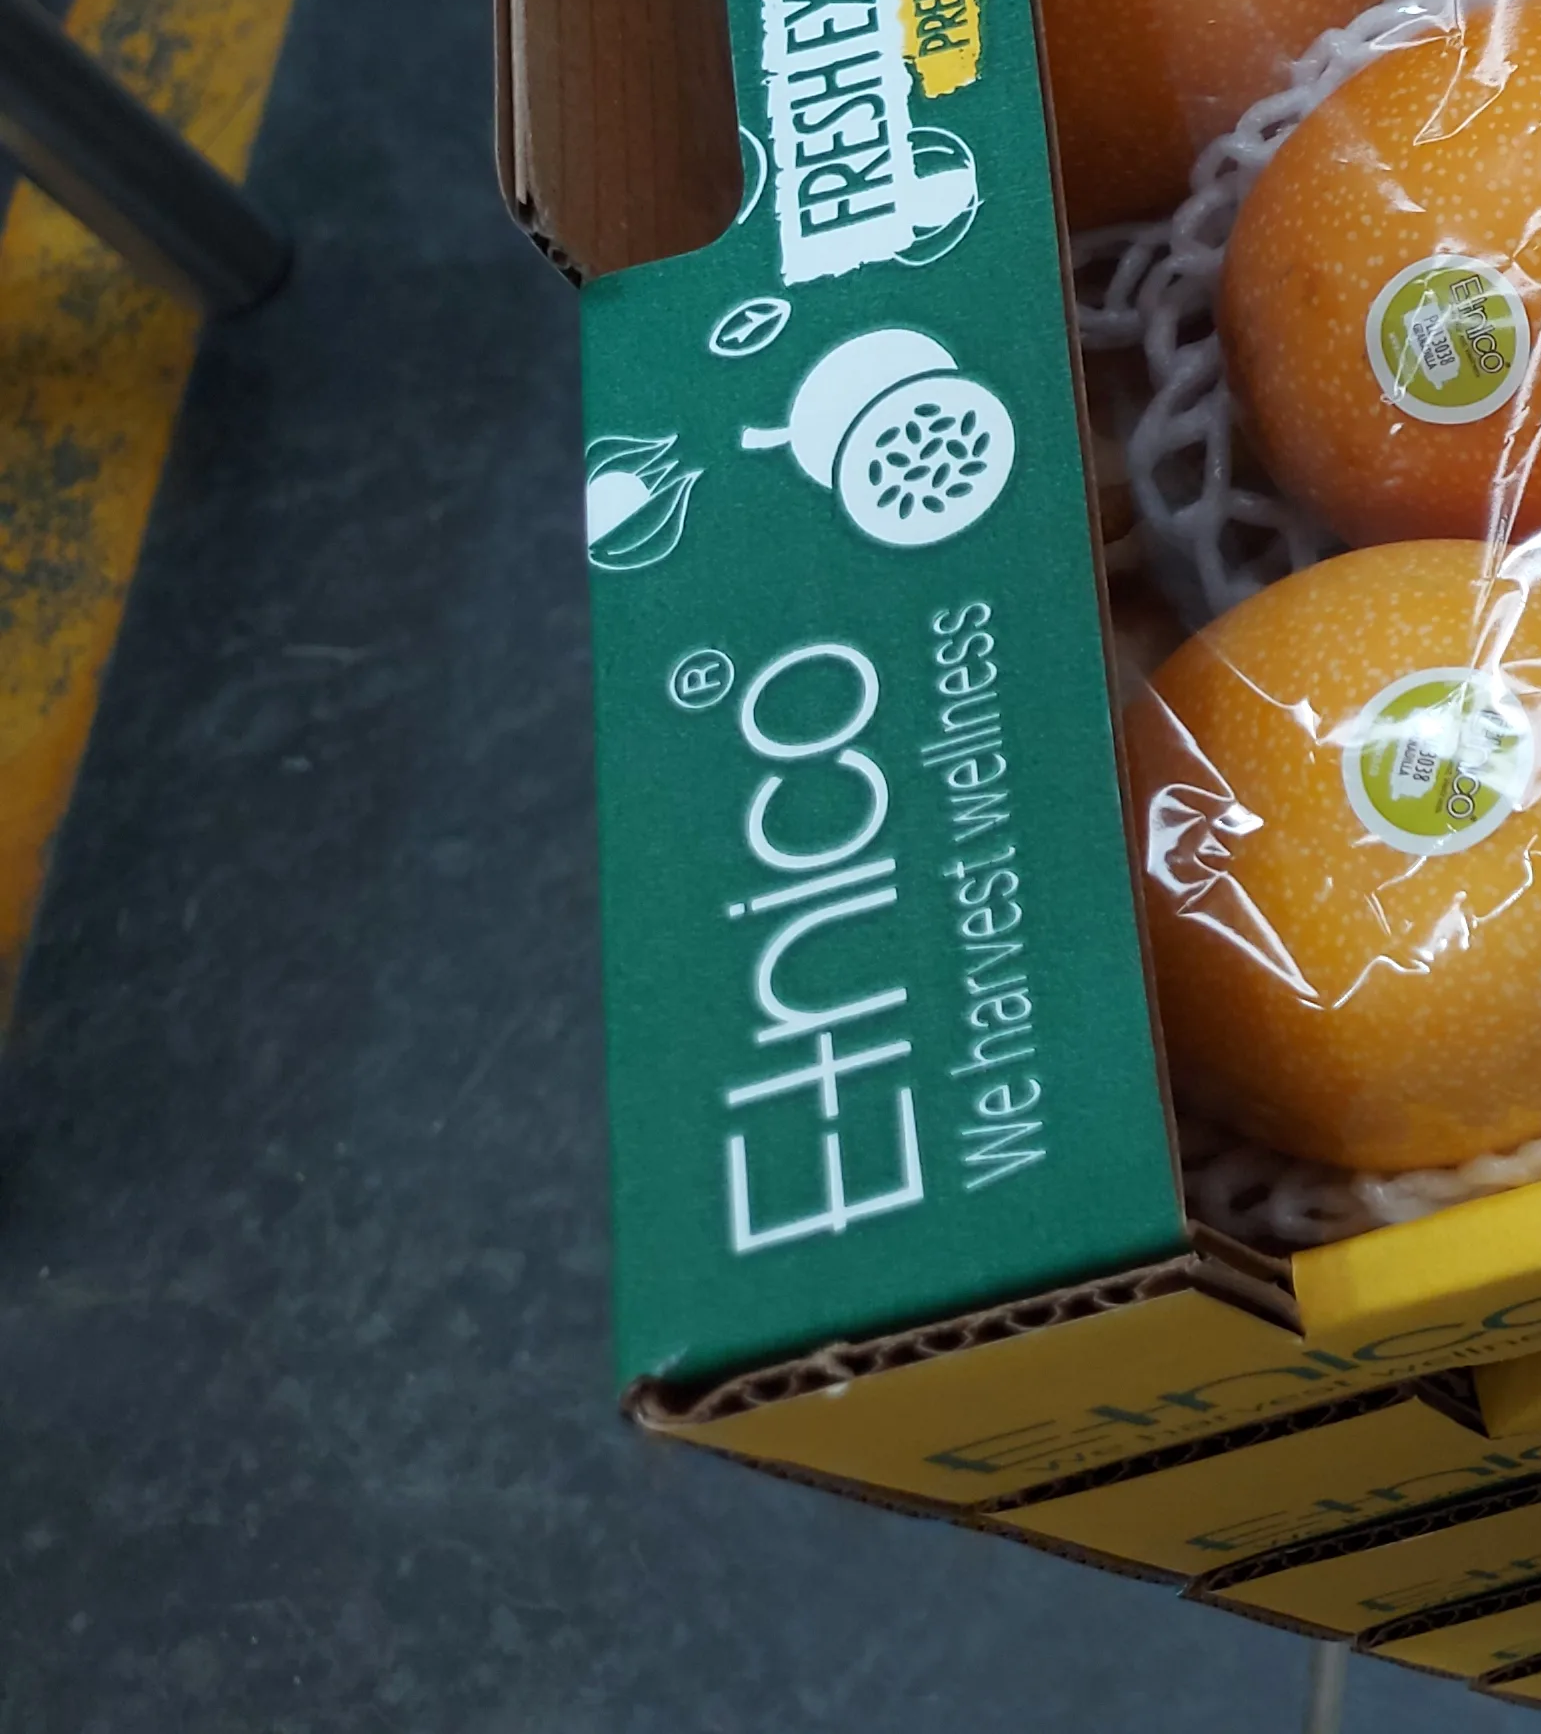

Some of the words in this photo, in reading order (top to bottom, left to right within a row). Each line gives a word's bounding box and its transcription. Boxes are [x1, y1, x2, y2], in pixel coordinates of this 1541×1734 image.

[789, 50, 897, 239] FRESH
[1432, 337, 1456, 366] 3038
[921, 600, 1011, 846] wellness
[1413, 750, 1437, 783] 3038
[942, 841, 1038, 1078] harvest
[961, 1074, 1047, 1191] We
